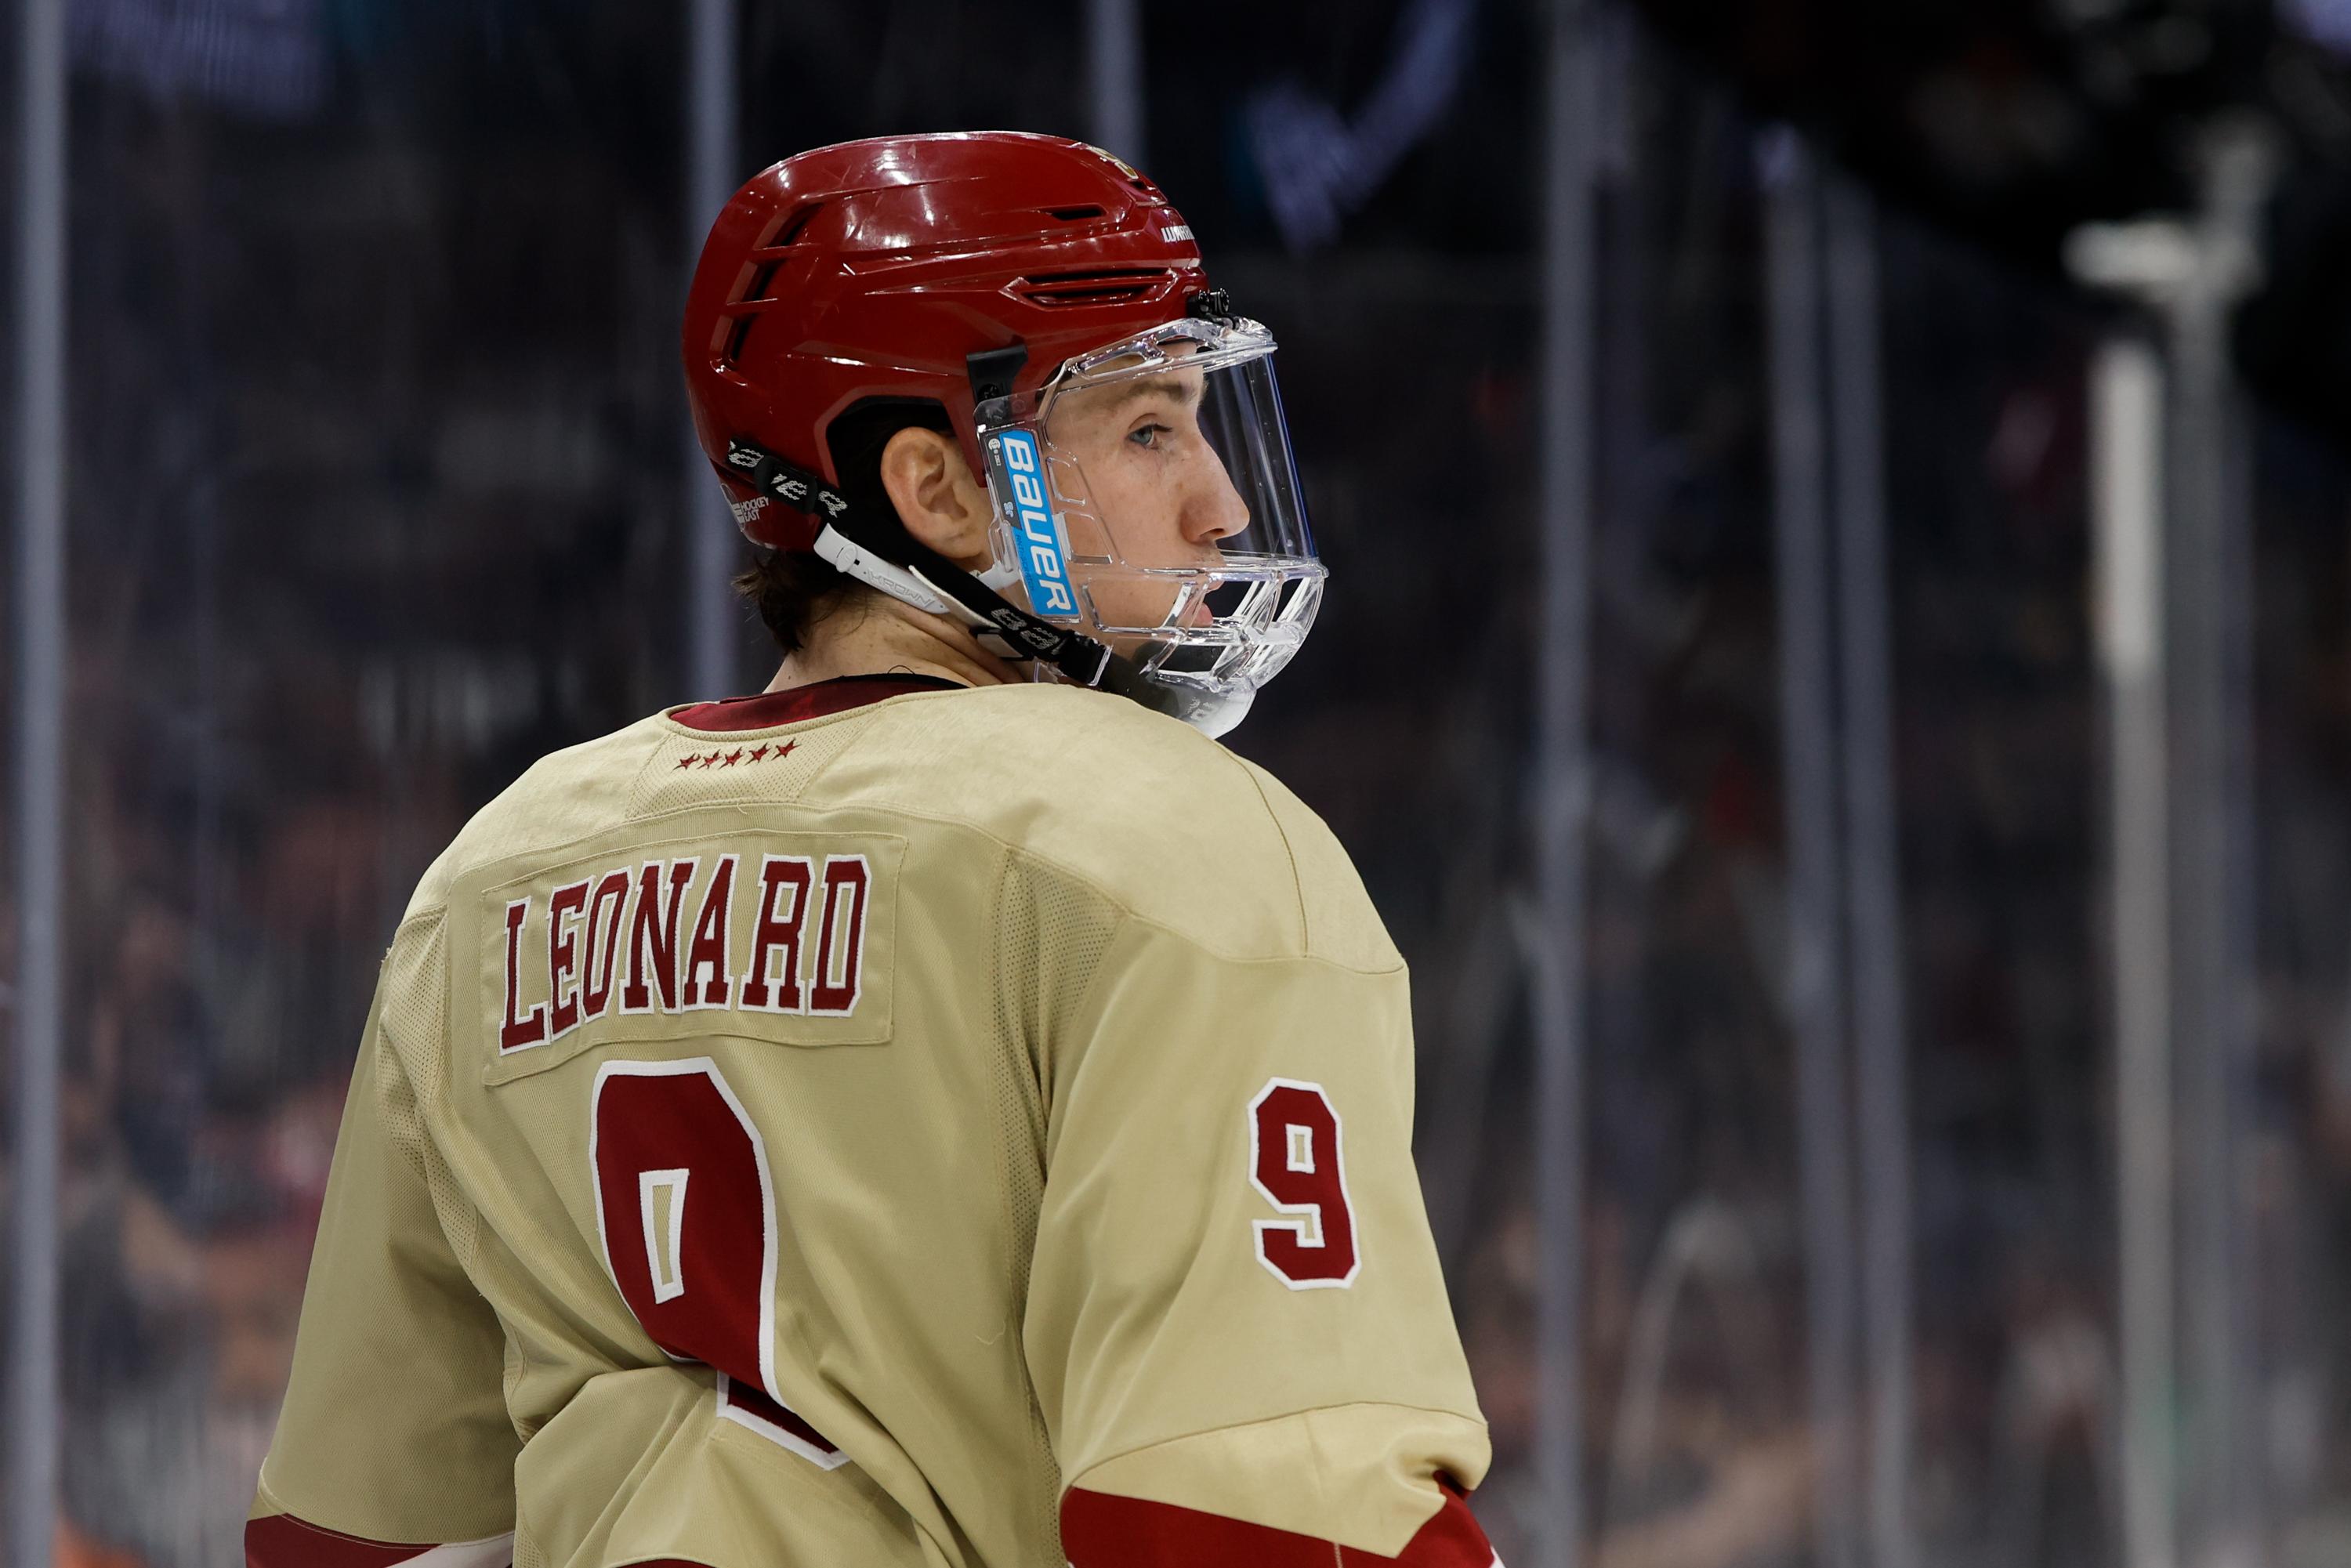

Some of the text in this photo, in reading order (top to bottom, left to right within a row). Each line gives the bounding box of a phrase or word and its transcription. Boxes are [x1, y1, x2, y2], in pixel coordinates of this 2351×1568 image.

[739, 496, 770, 511] HOCKEY
[744, 509, 761, 523] EAST
[499, 853, 872, 1056] LEONARD
[1248, 1077, 1362, 1291] 9
